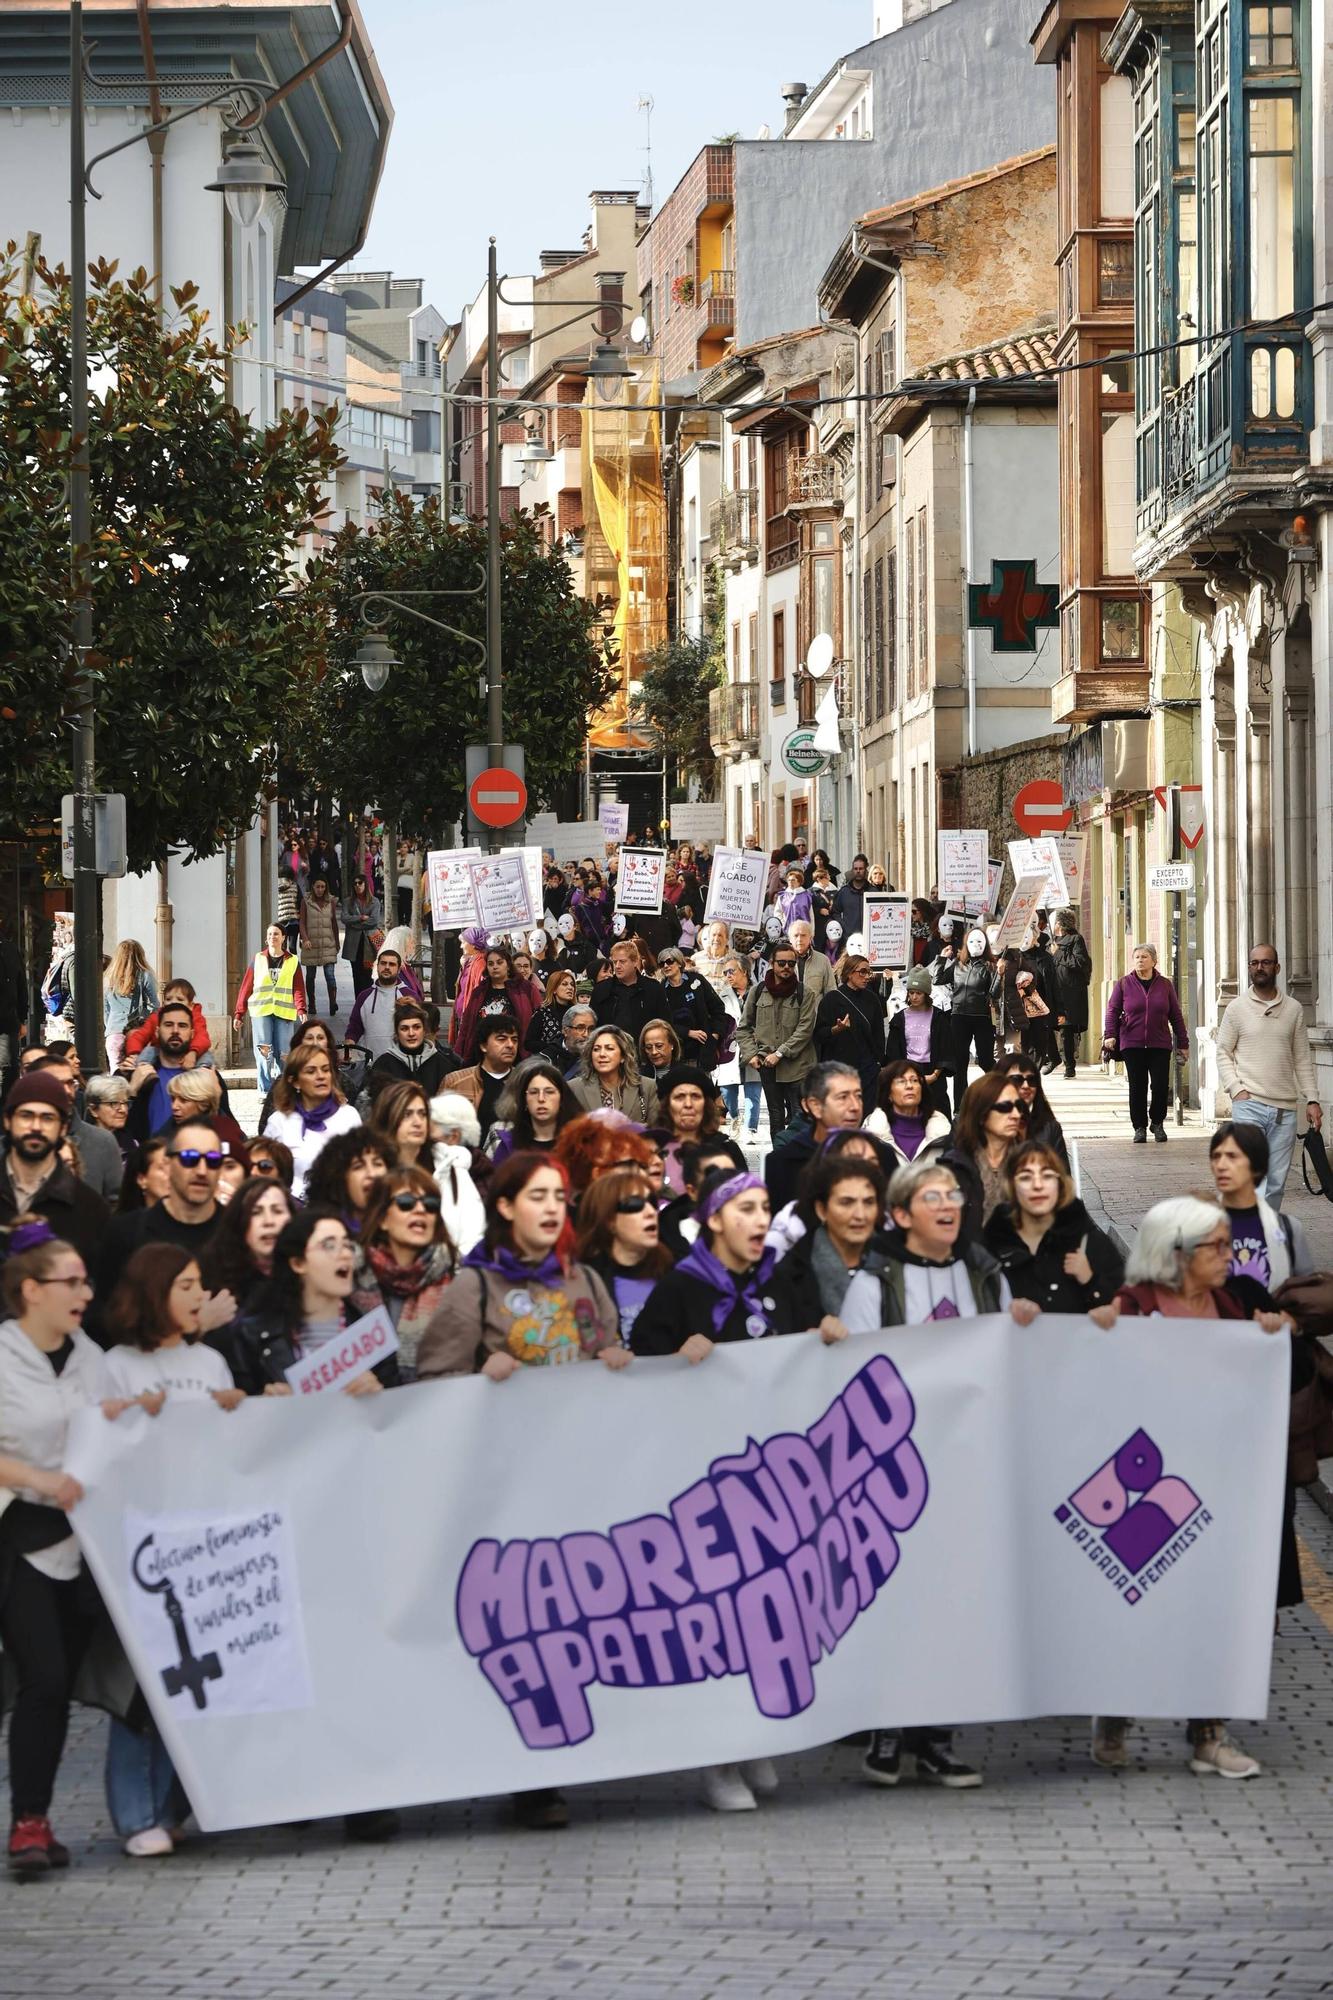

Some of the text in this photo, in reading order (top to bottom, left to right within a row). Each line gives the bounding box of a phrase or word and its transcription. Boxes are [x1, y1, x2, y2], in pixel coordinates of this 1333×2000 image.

[720, 872, 756, 884] ACABÓ!
[1156, 868, 1184, 878] EXCEPTO
[1152, 877, 1189, 887] RESIDENTES
[736, 888, 750, 896] SON
[720, 894, 751, 904] MUERTES
[726, 903, 743, 911] SON
[713, 911, 753, 922] ASESINATOS
[456, 1354, 915, 1657] MADREÑAZU
[1065, 1518, 1130, 1591] BRIGADA
[1138, 1508, 1215, 1593] FEMINISTA
[185, 1573, 204, 1597] de
[254, 1577, 282, 1608] del
